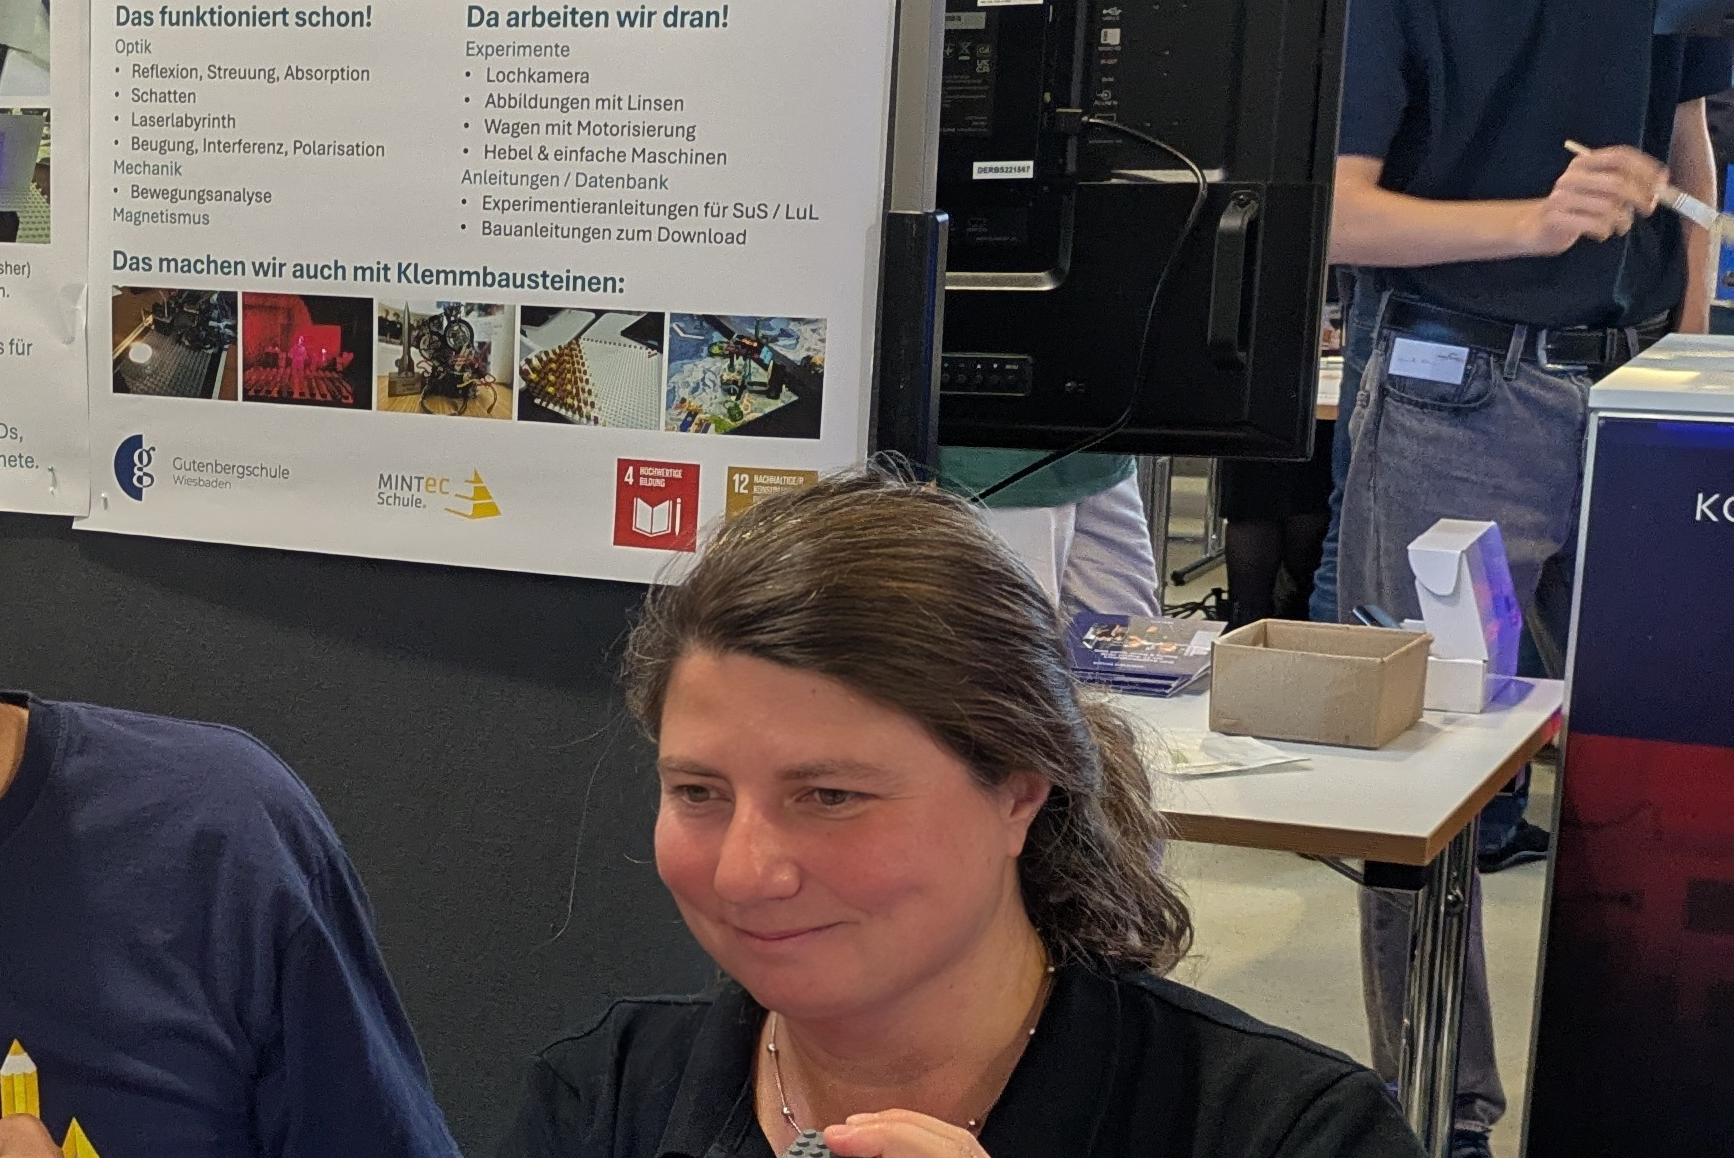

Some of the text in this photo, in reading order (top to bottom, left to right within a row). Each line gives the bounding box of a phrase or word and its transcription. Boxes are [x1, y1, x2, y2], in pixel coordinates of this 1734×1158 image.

[116, 5, 373, 28] Das funktioniert schon!
[466, 4, 729, 28] Da arbeiten wir dran!
[115, 38, 152, 57] Optik
[465, 40, 571, 60] Experimente
[132, 63, 371, 84] Reflexion, Streuung, Absorption
[486, 66, 590, 84] Lochkamera
[131, 88, 197, 104] Schatten
[484, 93, 684, 114] Abbildungen mit Linsen
[131, 112, 236, 132] Laserlabyrinth
[484, 118, 697, 142] Wagen mit Motorisierung
[131, 136, 385, 157] Beugung, Interferenz, Polarisation
[484, 143, 728, 166] Hebel & einfache Maschinen
[113, 160, 182, 177] Mechanik
[460, 169, 669, 191] Anleitungen / Datenbank
[130, 184, 272, 206] Bewegungsanalyse
[112, 207, 210, 227] Magnetismus
[482, 195, 819, 222] Experimentieranleitungen für SuS / LuL
[481, 220, 747, 246] Bauanleitungen zum Download
[112, 250, 625, 295] Das machen wir auch mit Klemmbausteinen:
[9, 338, 33, 356] für
[172, 456, 290, 480] Gutenbergschule
[624, 466, 634, 485] 4
[172, 474, 232, 491] Wiesbaden
[732, 473, 749, 494] 12
